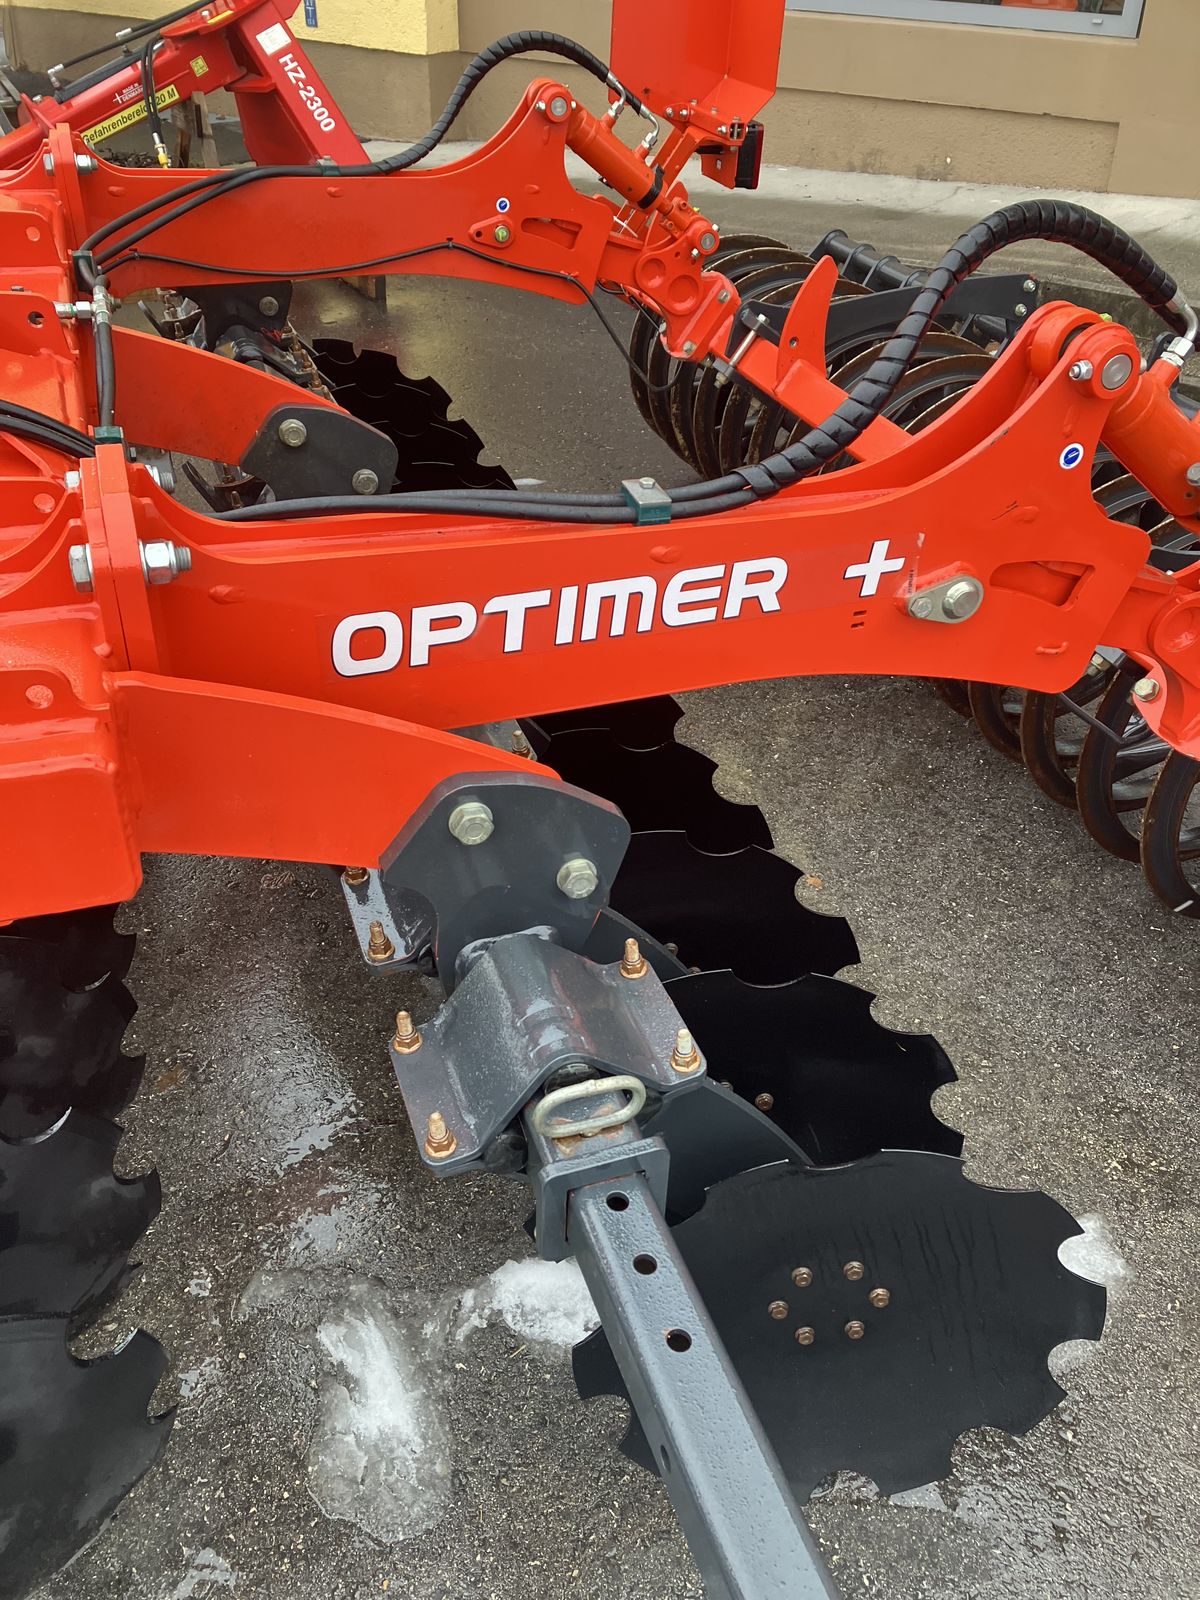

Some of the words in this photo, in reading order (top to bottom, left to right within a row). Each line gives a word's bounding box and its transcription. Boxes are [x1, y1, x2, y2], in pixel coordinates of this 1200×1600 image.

[82, 104, 148, 144] Gefahrenbereic
[155, 93, 166, 106] 20
[167, 87, 176, 100] M
[279, 53, 336, 132] HZ-2300
[331, 556, 789, 678] OPTIMER
